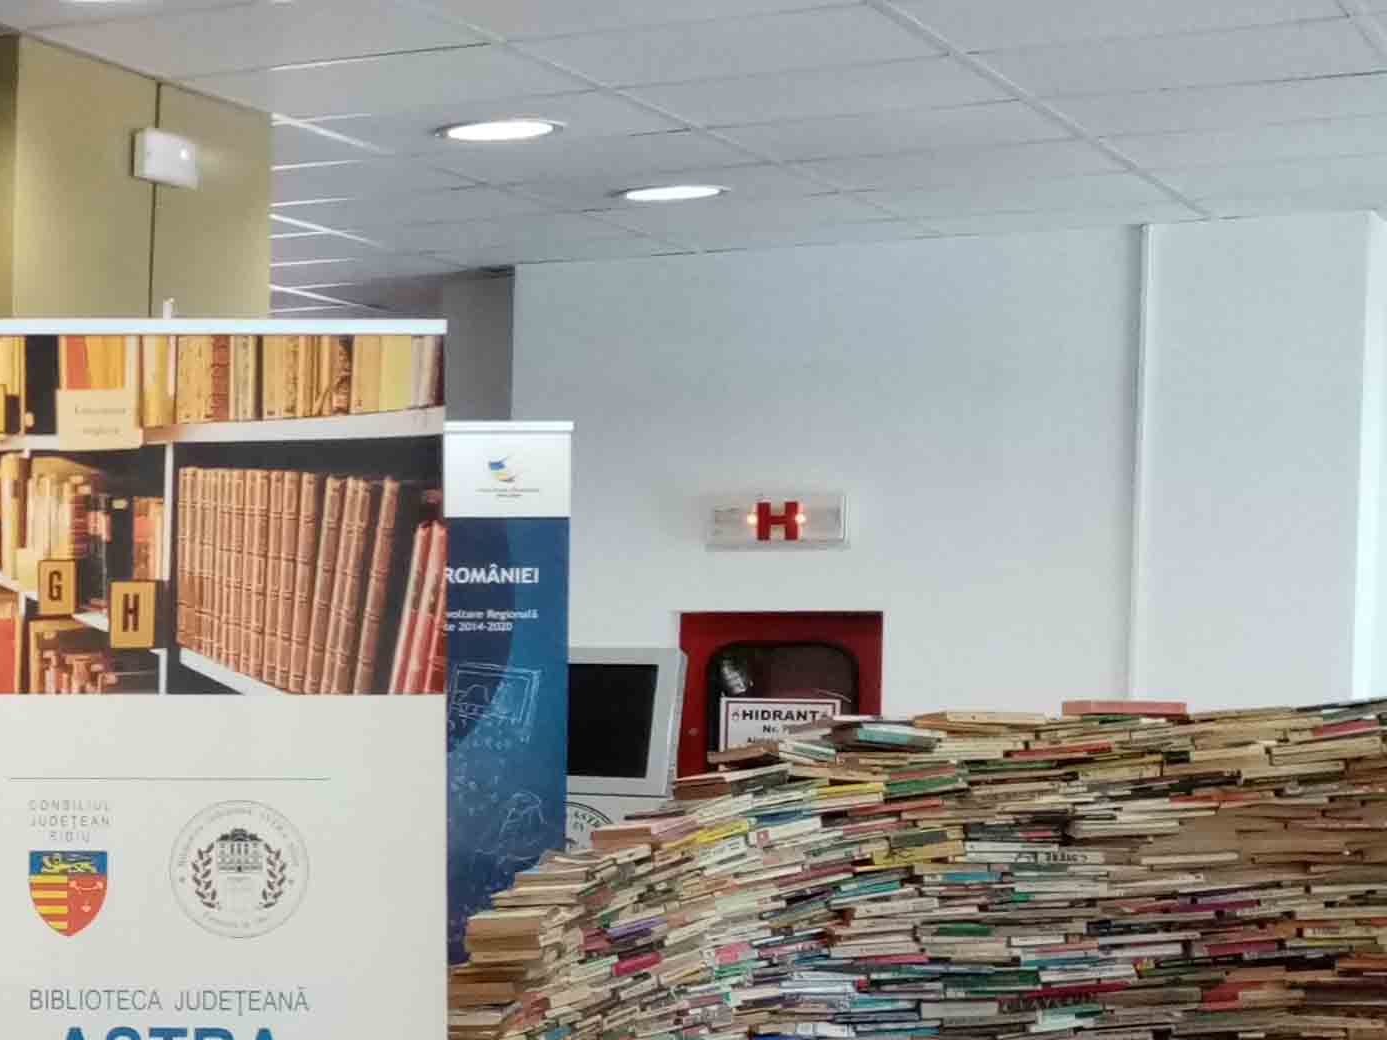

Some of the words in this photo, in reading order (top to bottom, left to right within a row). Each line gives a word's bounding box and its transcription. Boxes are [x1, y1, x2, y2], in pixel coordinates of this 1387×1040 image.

[757, 501, 798, 541] H
[48, 570, 63, 601] G
[122, 593, 140, 632] H
[742, 709, 820, 722] HIDRANT
[28, 799, 111, 811] CONSILIUL
[29, 989, 163, 1012] BIBLIOTECA
